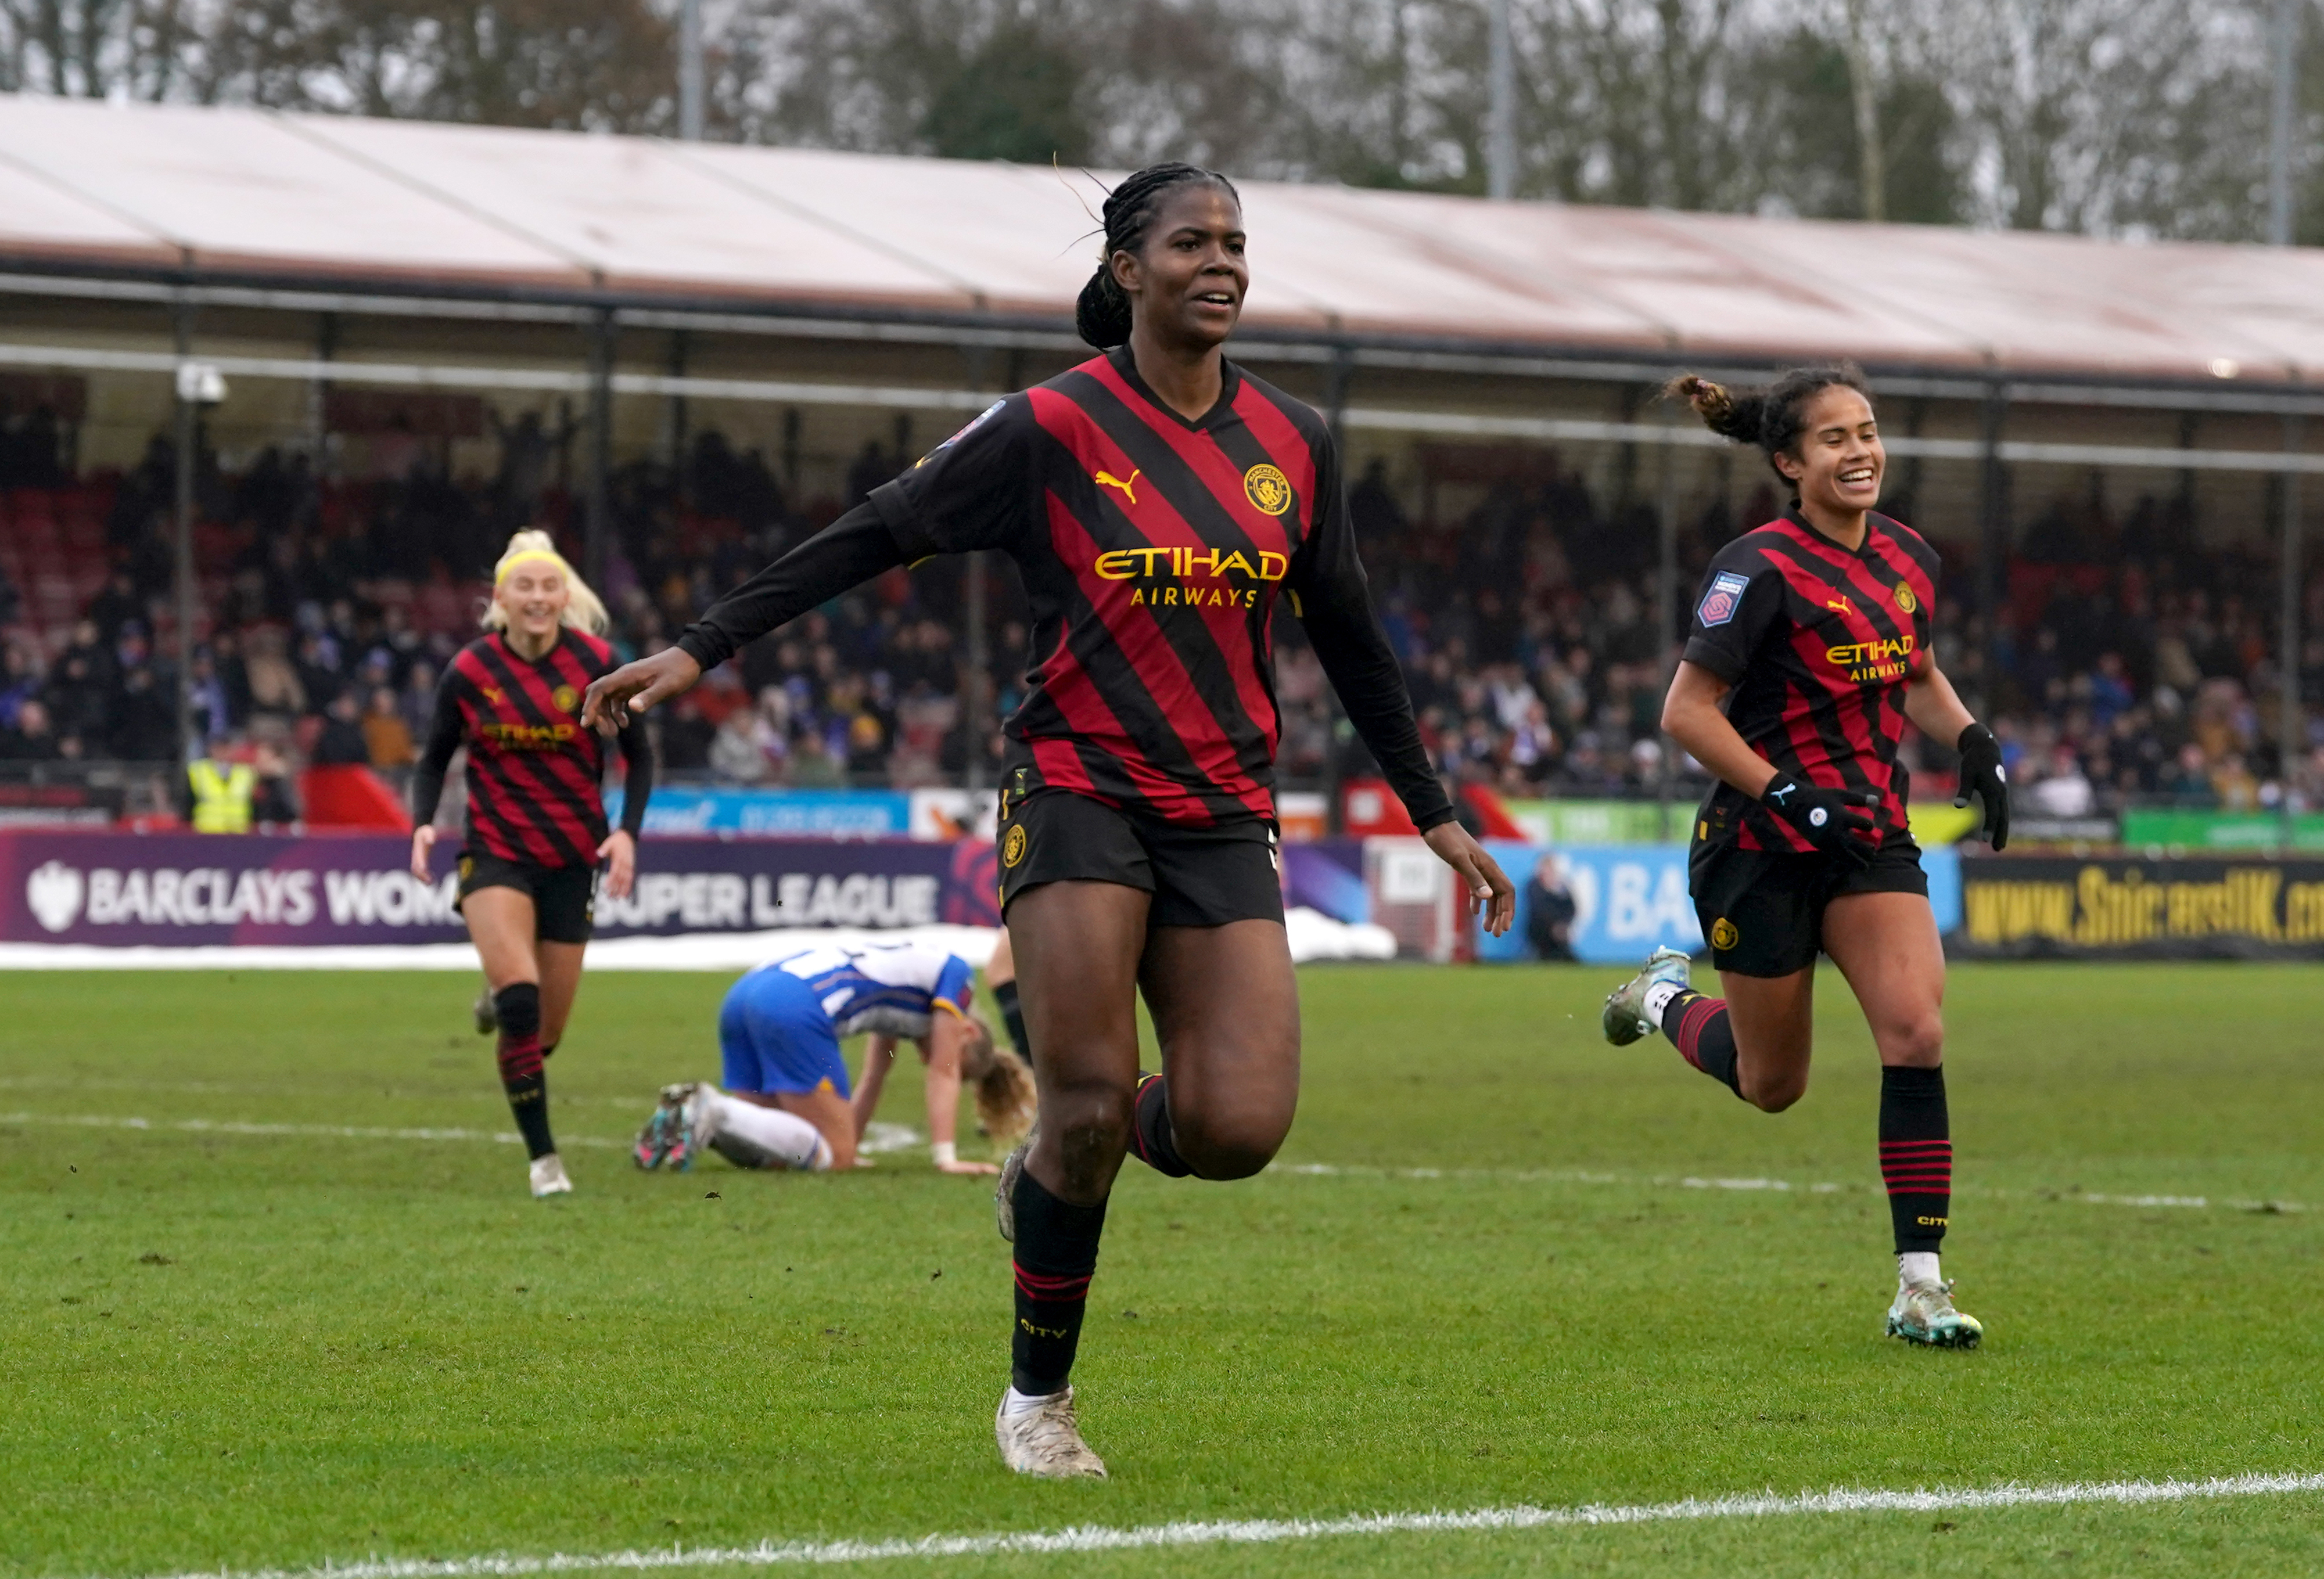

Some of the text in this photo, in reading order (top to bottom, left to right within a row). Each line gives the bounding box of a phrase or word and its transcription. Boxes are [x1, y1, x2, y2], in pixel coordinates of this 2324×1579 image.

[1094, 546, 1287, 581] ETIHAD
[1130, 587, 1258, 608] AIRWAYS
[1826, 635, 1914, 664] ETIHAD
[1849, 661, 1906, 682] AIRWAYS
[87, 868, 940, 928] BARCLAYS WOM SUPER LEAGUE
[1607, 862, 1703, 942] BA
[1021, 1318, 1067, 1339] CITY
